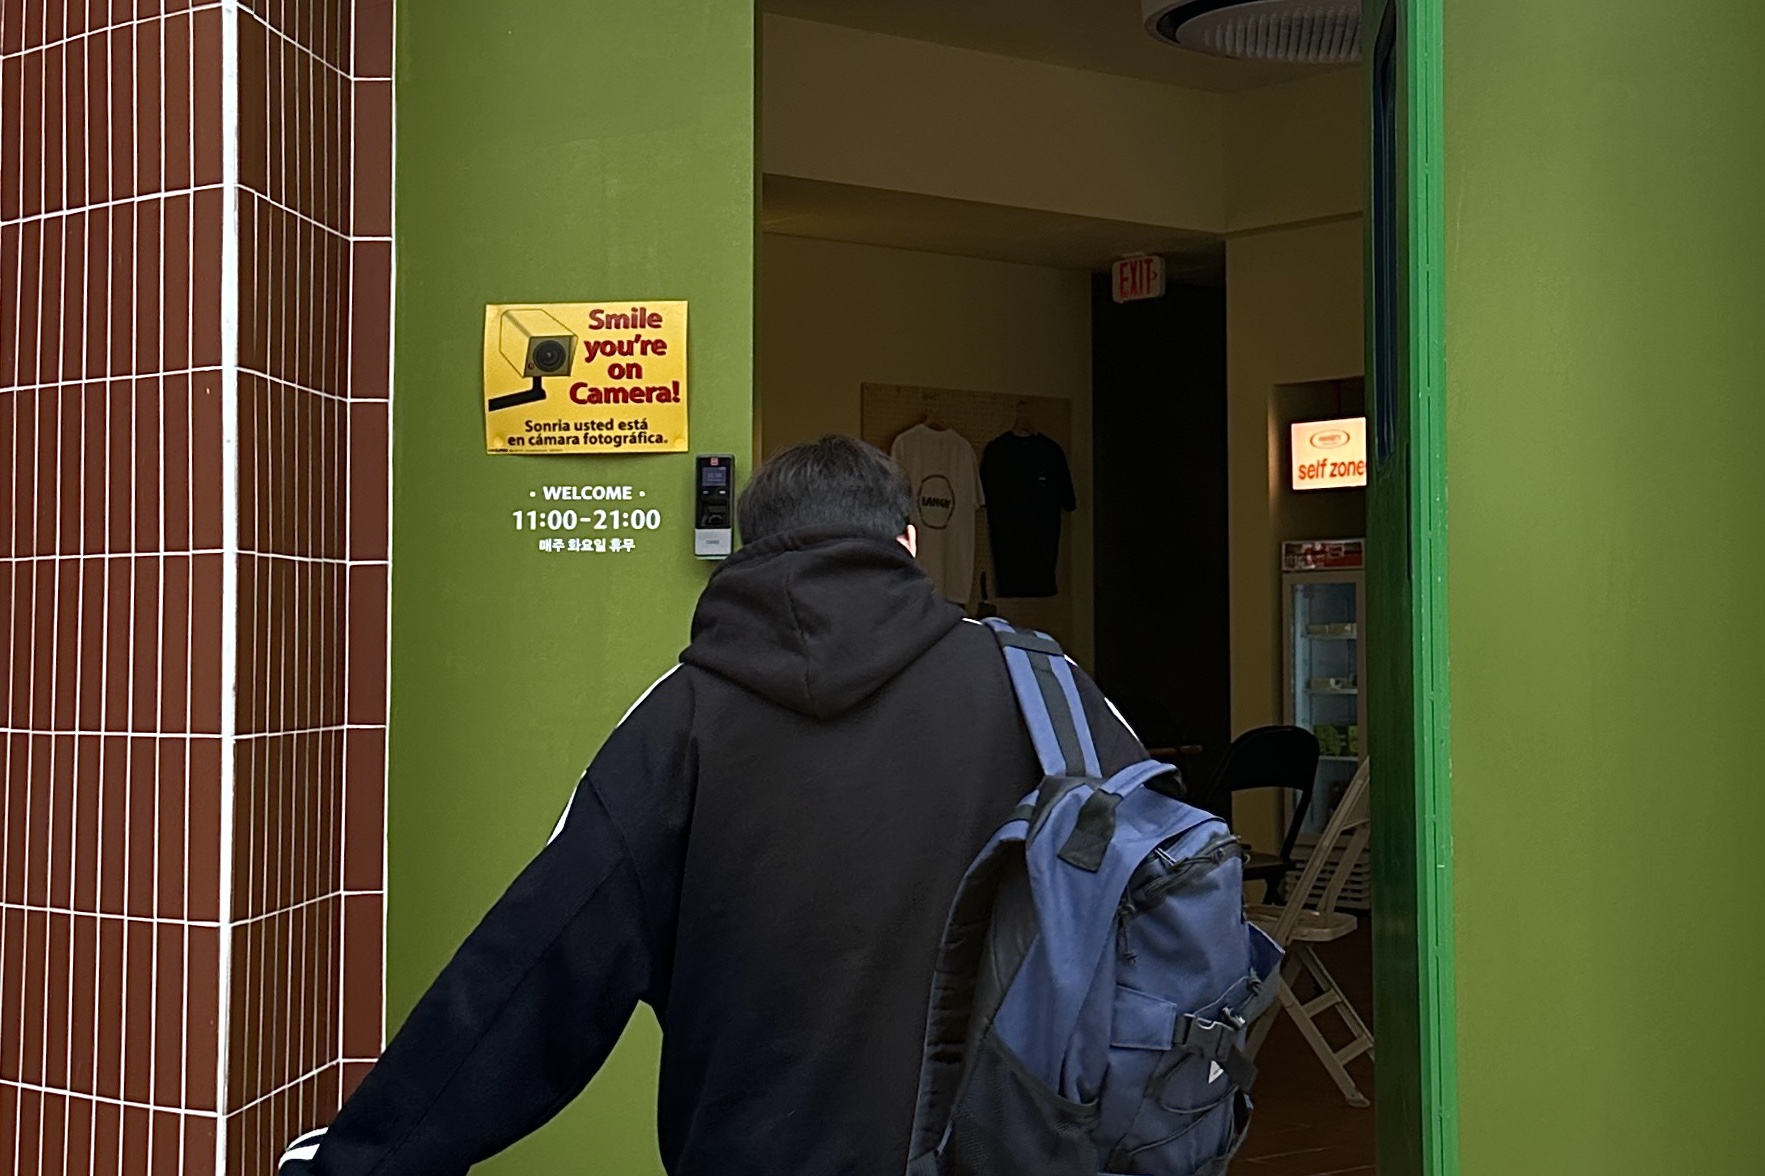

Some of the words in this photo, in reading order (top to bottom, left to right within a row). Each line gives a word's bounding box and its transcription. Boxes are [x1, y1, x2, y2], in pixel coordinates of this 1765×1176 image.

[1119, 258, 1154, 298] EXIT
[588, 307, 663, 330] Smile
[584, 334, 668, 363] you're
[608, 362, 643, 380] on
[569, 380, 681, 404] Camera!
[524, 419, 571, 432] Sonria
[574, 418, 614, 431] usted
[618, 418, 648, 431] está
[507, 436, 525, 446] en
[528, 433, 580, 446] cámara
[583, 432, 668, 448] fotográfica.
[1298, 458, 1328, 480] self
[1329, 459, 1365, 478] zone
[543, 486, 632, 500] WELCOME
[512, 509, 661, 530] 11:00-21:00
[538, 538, 565, 552] 매주
[567, 538, 606, 553] 화요일
[609, 538, 636, 552] 휴무
